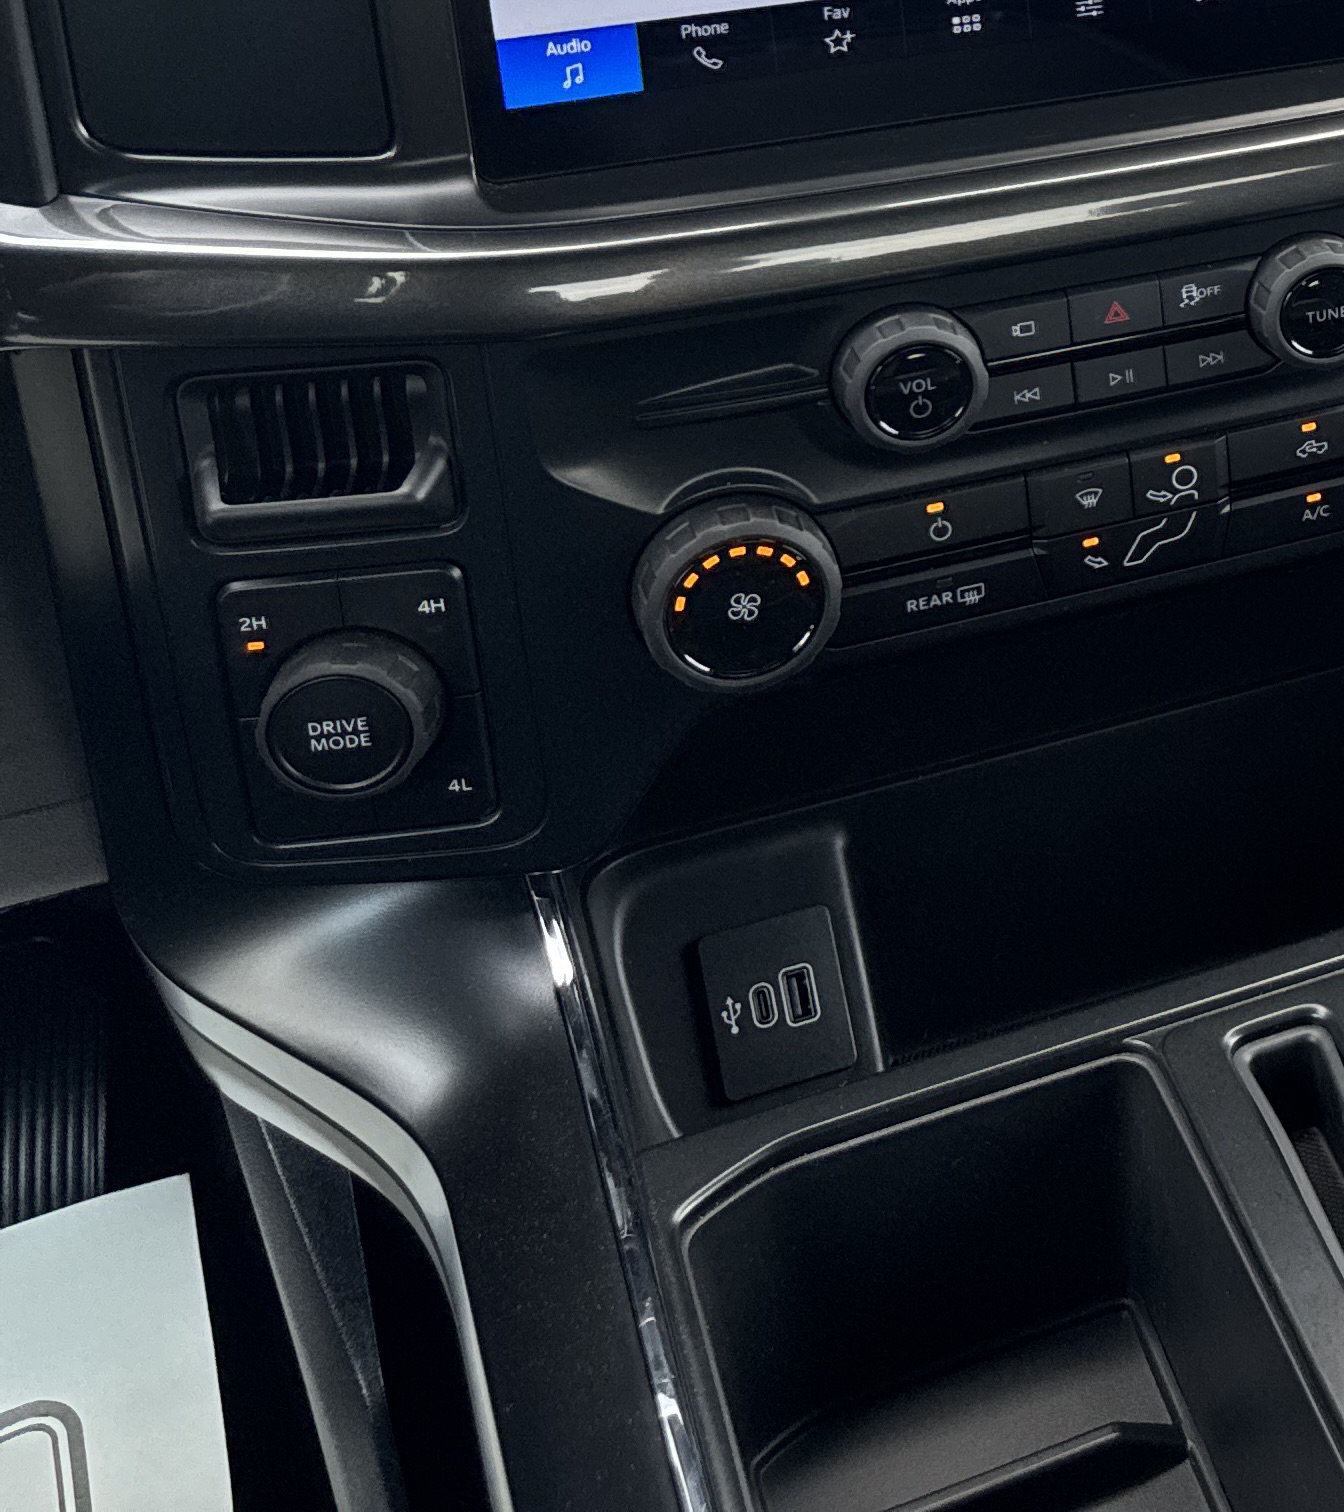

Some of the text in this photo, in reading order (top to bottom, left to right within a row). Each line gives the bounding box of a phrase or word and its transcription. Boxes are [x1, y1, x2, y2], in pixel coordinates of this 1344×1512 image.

[823, 5, 850, 22] Fav
[680, 19, 730, 39] Phone
[546, 38, 592, 56] Audio
[1198, 284, 1221, 298] OFF
[899, 377, 936, 396] VOL
[1302, 504, 1331, 522] A/C
[417, 598, 446, 615] 4H
[906, 590, 953, 614] REAR
[239, 615, 267, 632] 2H
[307, 717, 369, 737] DRIVE
[310, 732, 372, 752] MODE
[448, 778, 473, 792] 4L
